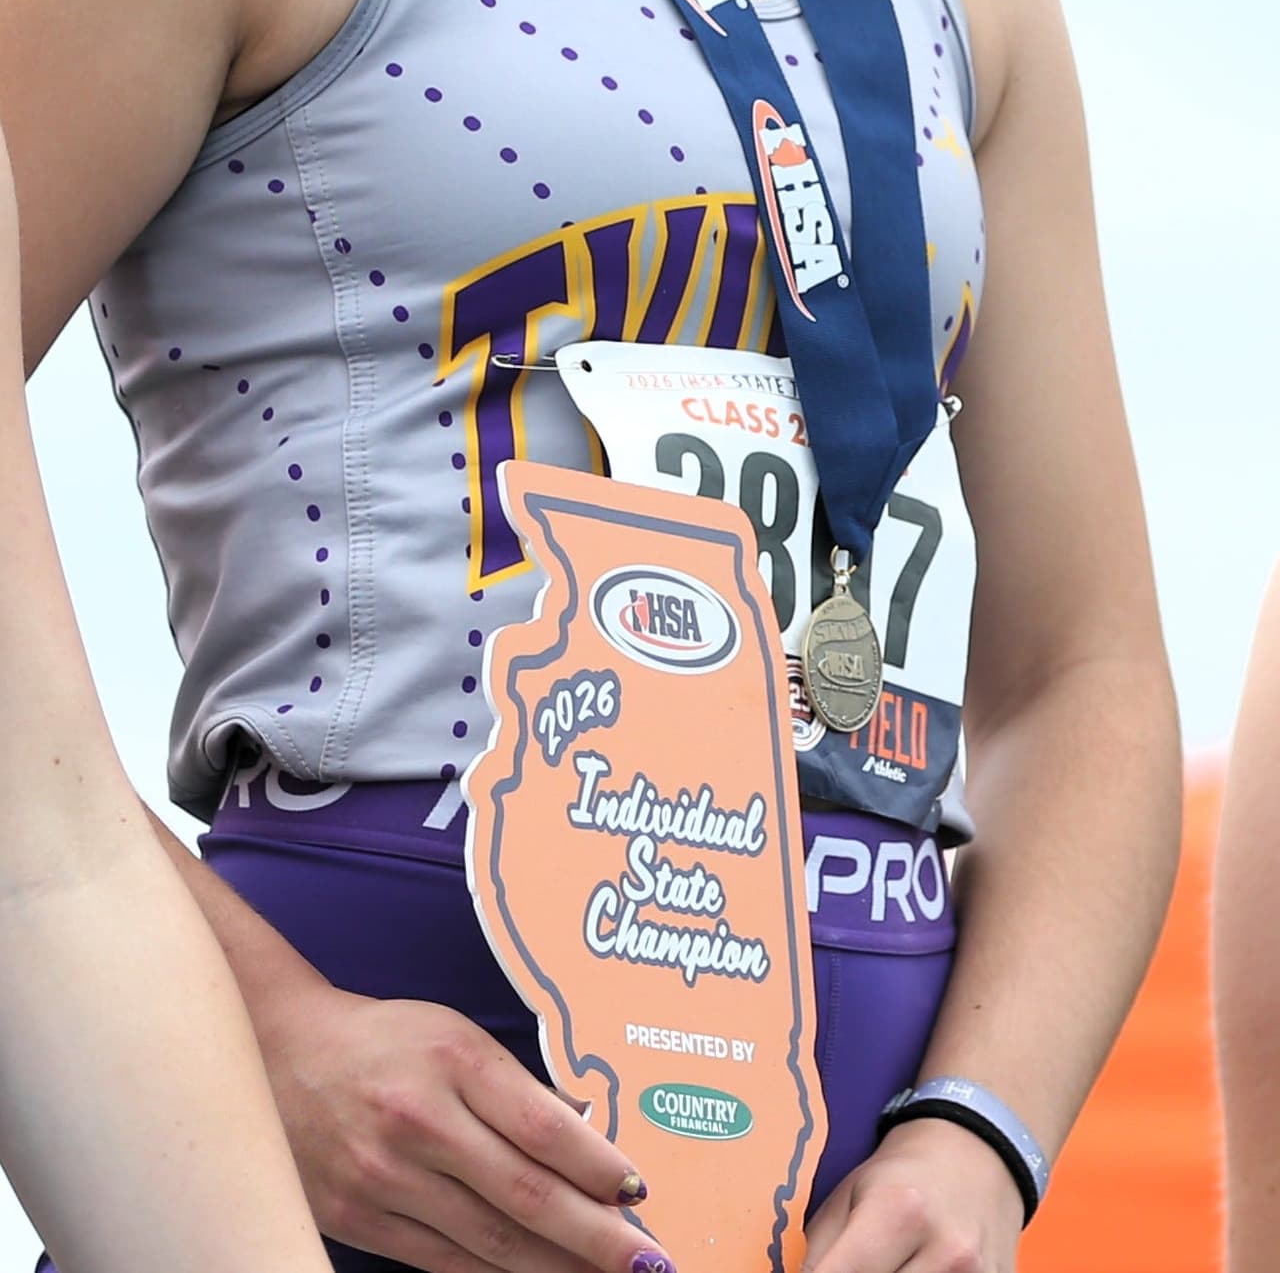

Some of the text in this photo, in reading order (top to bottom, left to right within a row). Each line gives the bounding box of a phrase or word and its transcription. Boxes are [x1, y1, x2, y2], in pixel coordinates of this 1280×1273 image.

[681, 396, 812, 448] CLASS 2
[731, 374, 785, 394] STATE
[538, 679, 615, 756] 2026
[850, 690, 929, 770] IELD
[569, 755, 765, 852] Individual
[622, 834, 724, 913] State
[805, 834, 945, 923] PRO
[586, 886, 768, 983] Champion
[625, 1023, 756, 1063] PRESENTED BY
[652, 1088, 738, 1124] COUNTRY
